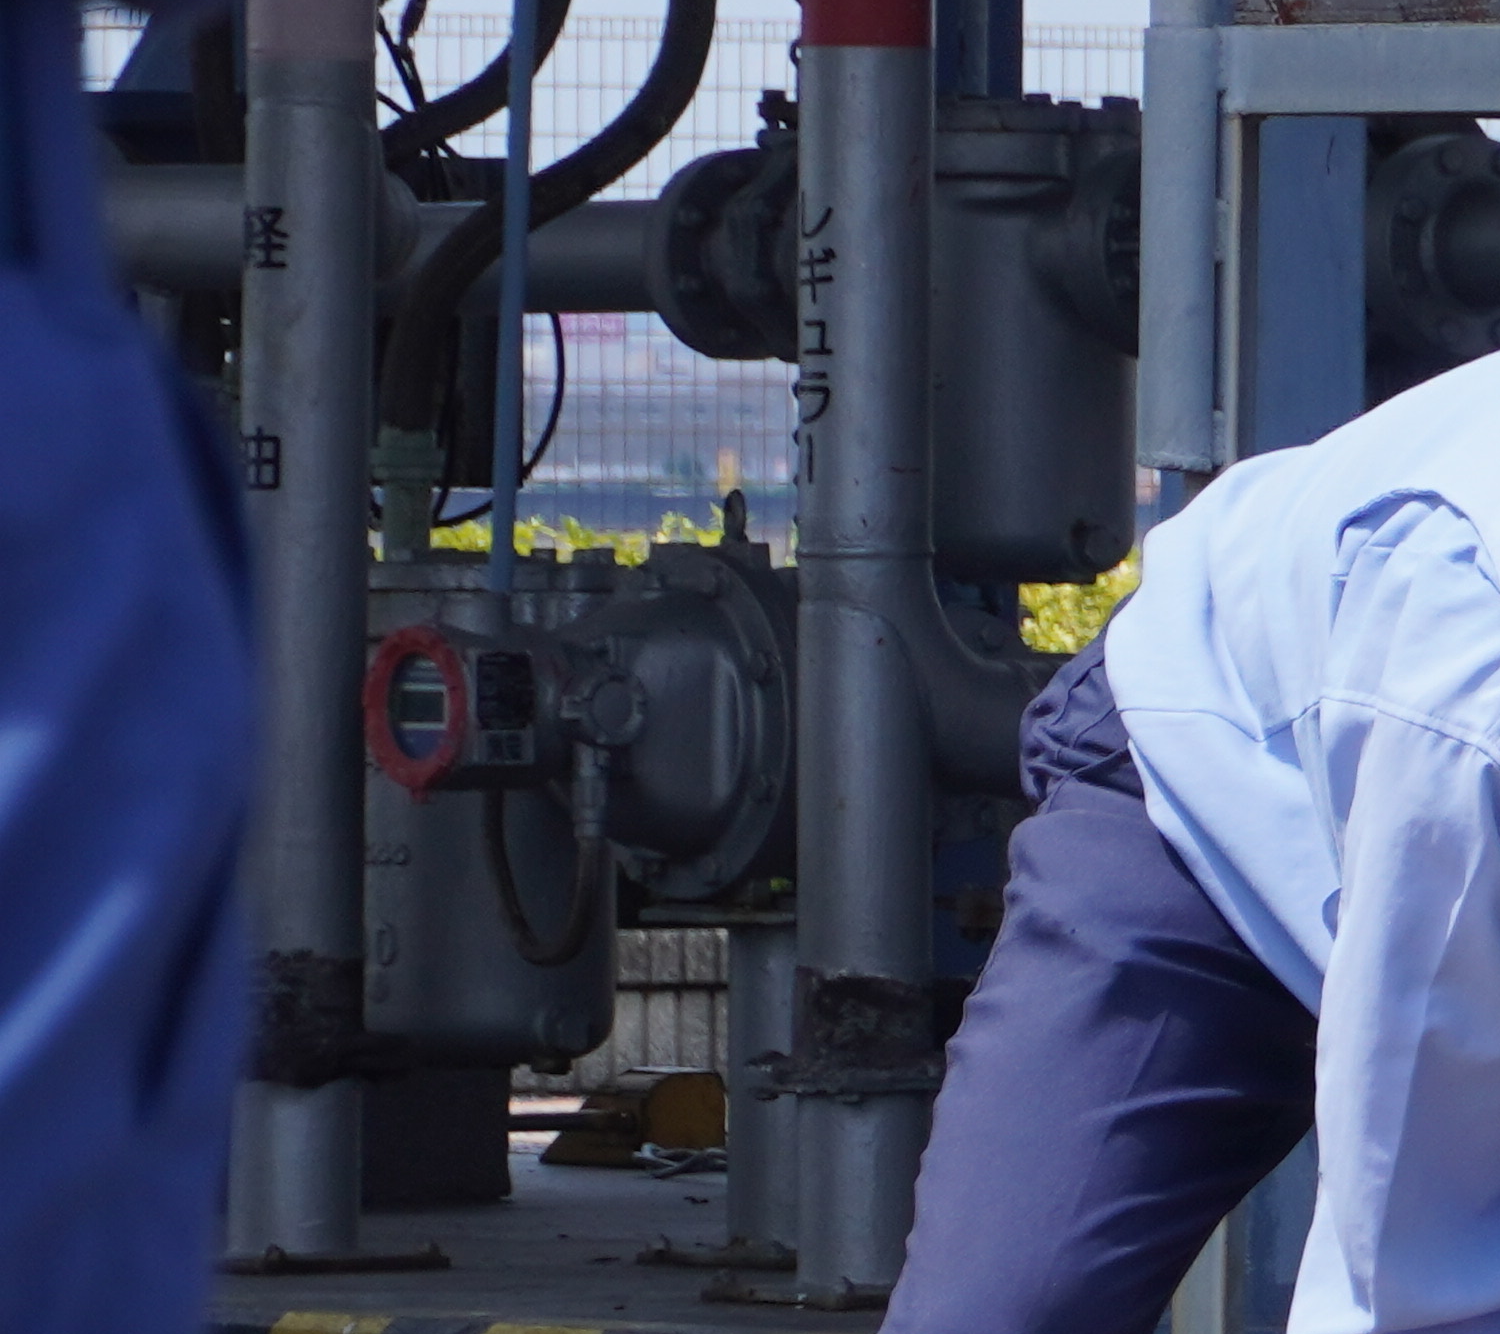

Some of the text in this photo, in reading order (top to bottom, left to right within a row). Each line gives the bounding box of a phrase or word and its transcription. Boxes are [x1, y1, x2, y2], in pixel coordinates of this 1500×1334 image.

[800, 190, 837, 484] レギュラー
